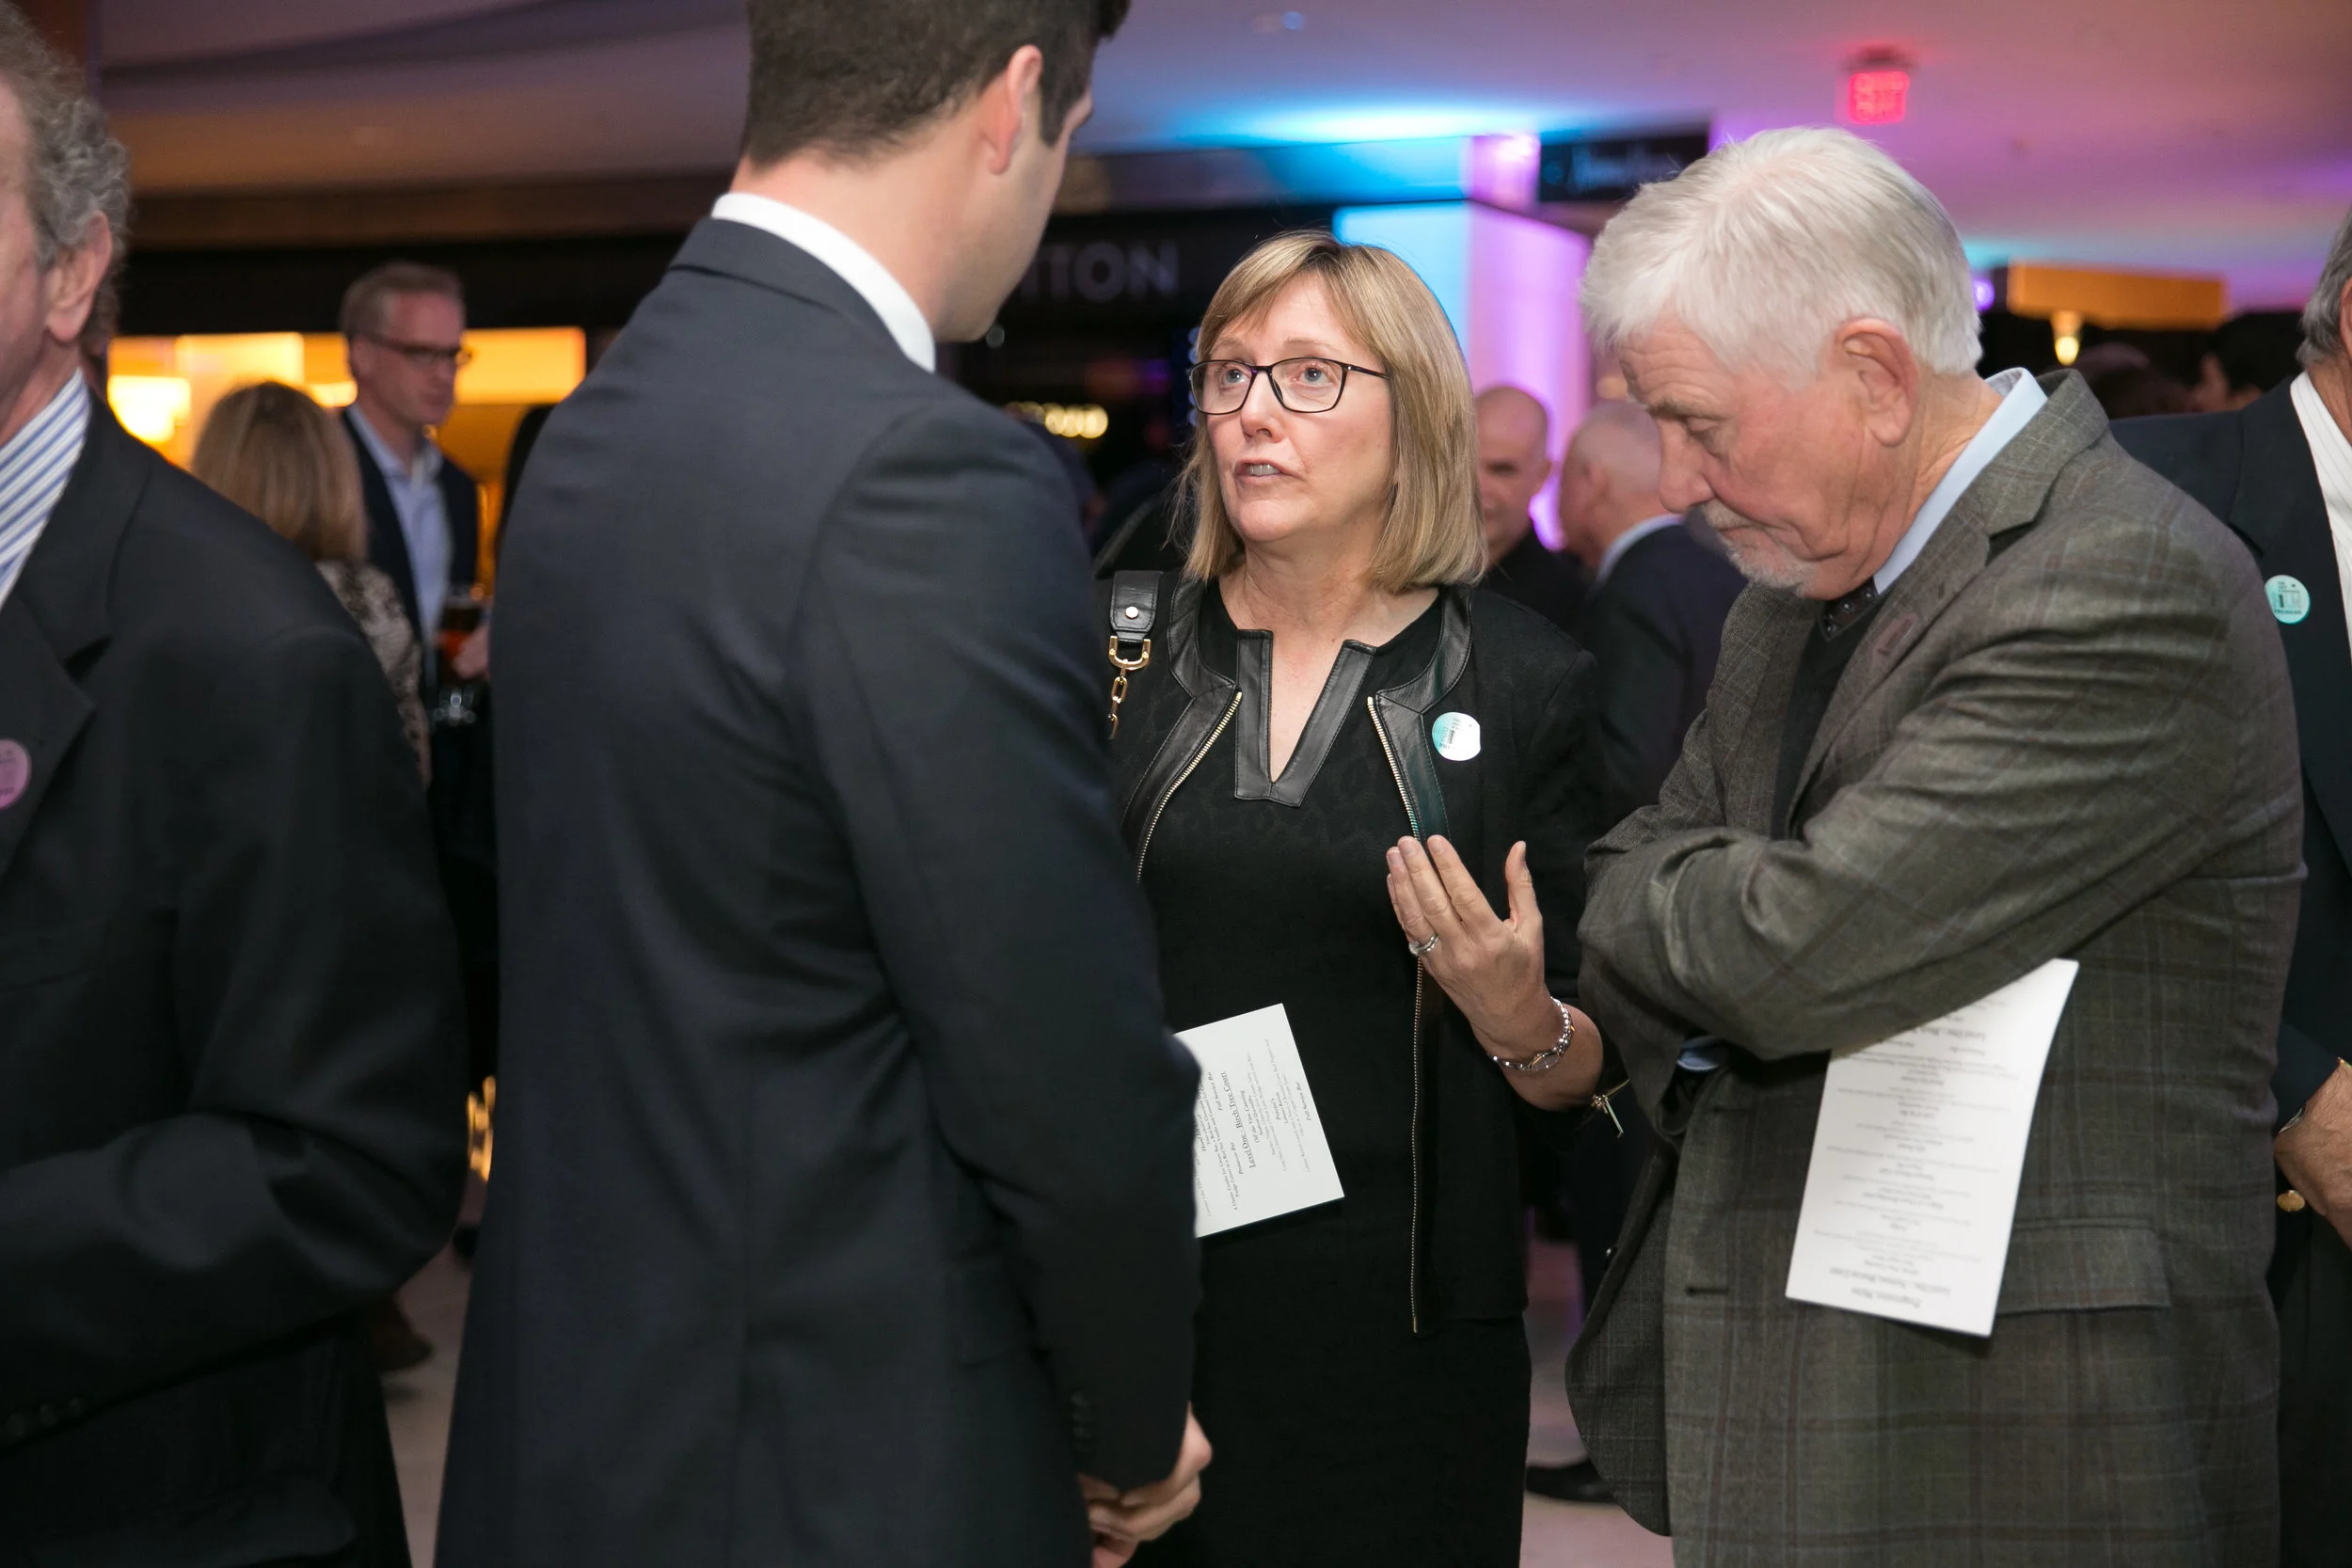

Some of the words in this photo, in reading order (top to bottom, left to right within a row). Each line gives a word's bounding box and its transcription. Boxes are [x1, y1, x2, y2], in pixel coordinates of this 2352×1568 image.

[1220, 1071, 1232, 1092] Court
[1227, 1091, 1237, 1110] Tree
[1232, 1109, 1244, 1129] Birch
[1241, 1132, 1250, 1149] One
[1244, 1148, 1256, 1168] Level
